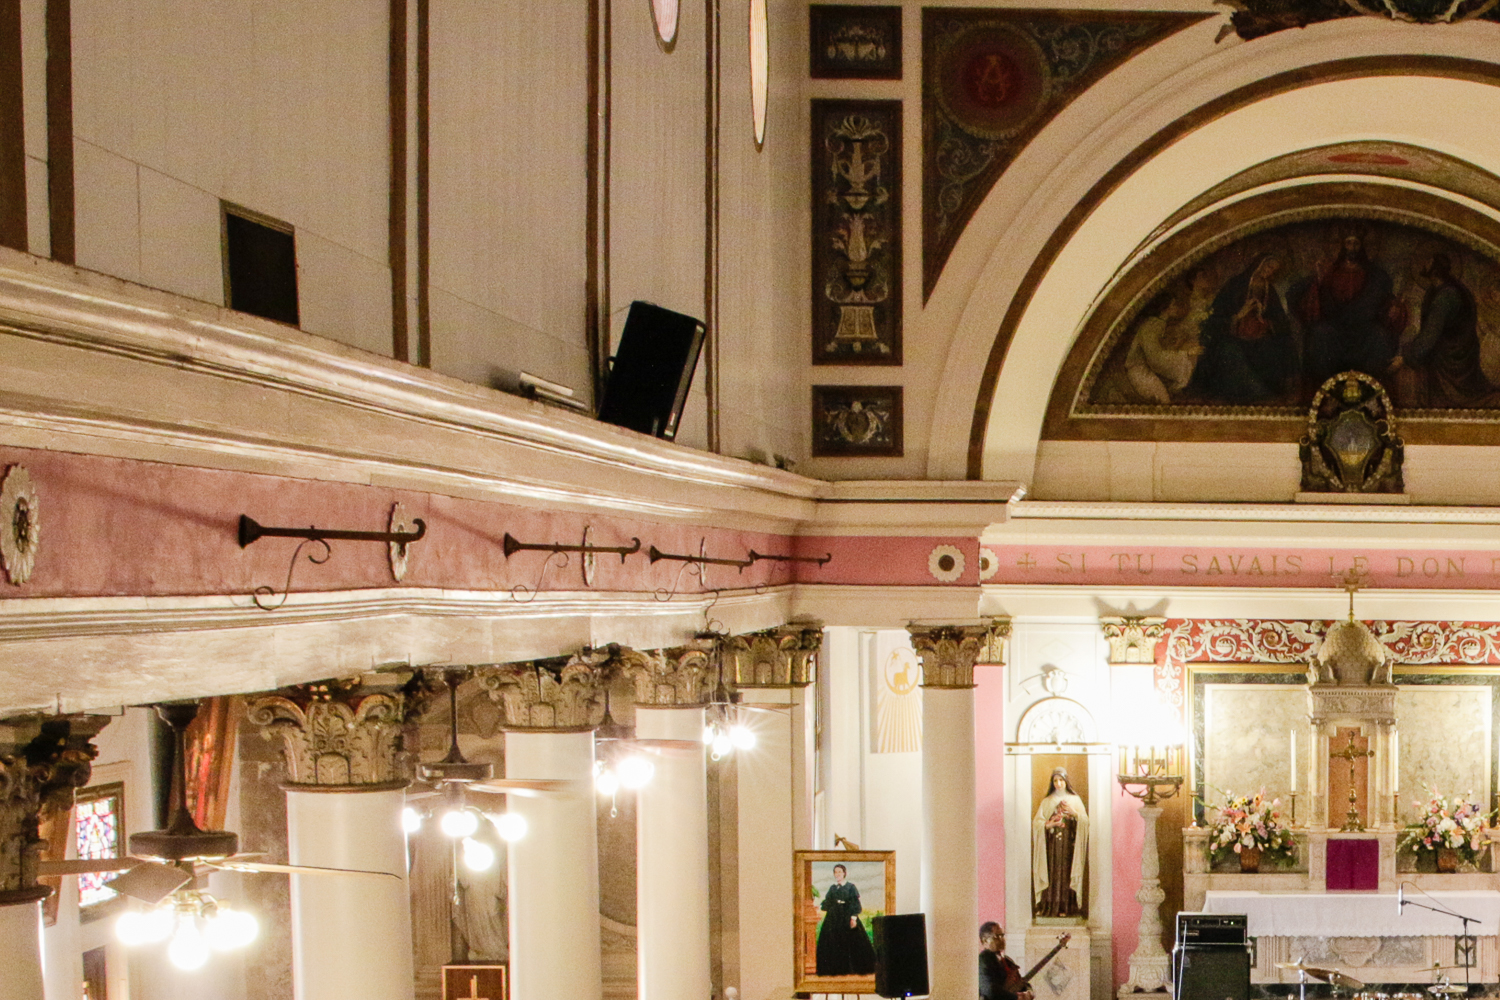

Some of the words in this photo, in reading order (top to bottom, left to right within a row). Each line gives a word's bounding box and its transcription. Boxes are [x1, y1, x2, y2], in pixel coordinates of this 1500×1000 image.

[1056, 553, 1087, 573] SI
[1110, 553, 1156, 575] TU
[1181, 554, 1302, 576] SAVAIS
[1329, 556, 1370, 577] LE
[1396, 557, 1466, 578] DON
